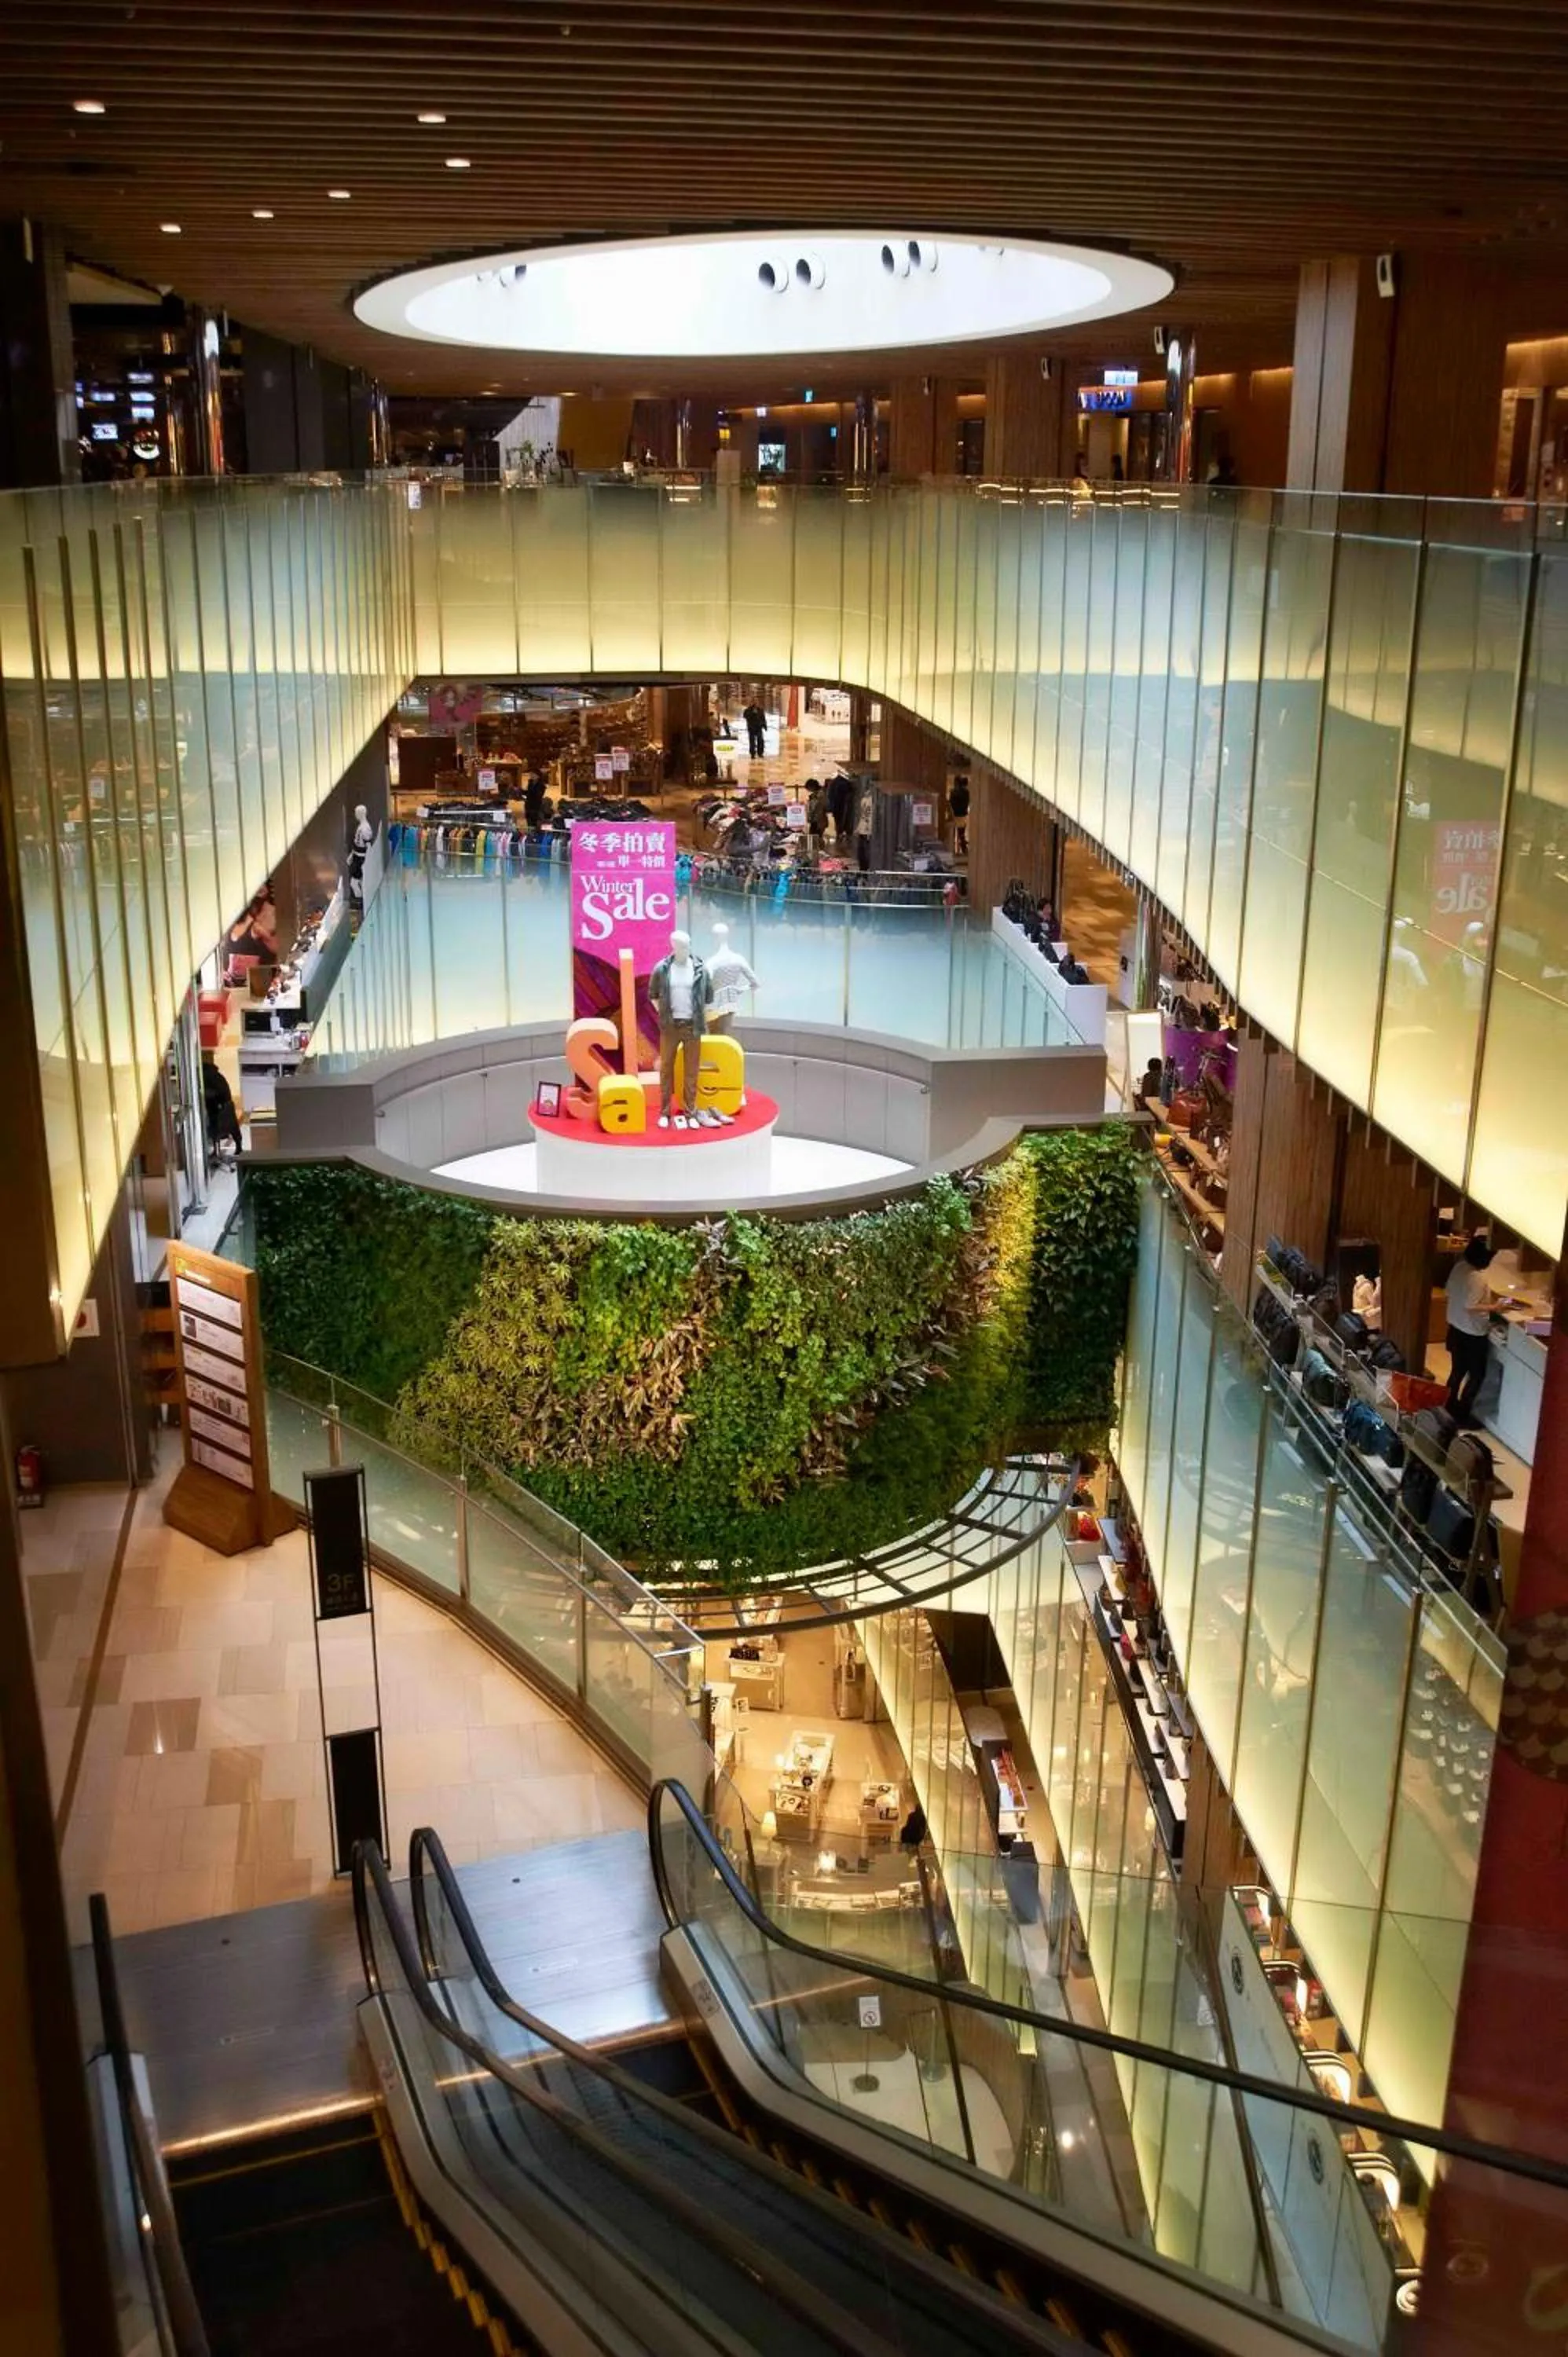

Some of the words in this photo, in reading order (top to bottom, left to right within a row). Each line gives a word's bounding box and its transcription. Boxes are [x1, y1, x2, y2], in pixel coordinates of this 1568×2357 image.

[578, 832, 665, 853] 冬季拍賣
[580, 875, 636, 893] Winter
[581, 878, 670, 940] Sale
[327, 1573, 356, 1593] 3F
